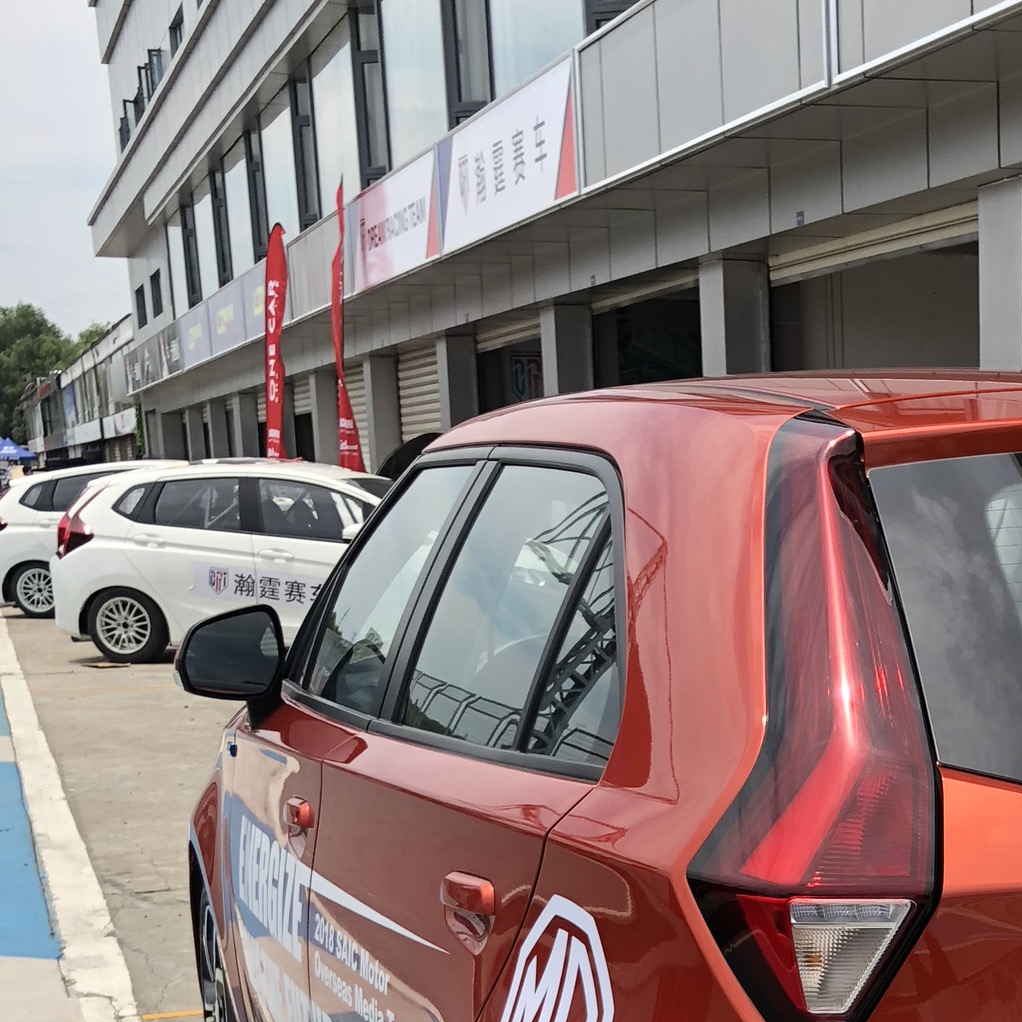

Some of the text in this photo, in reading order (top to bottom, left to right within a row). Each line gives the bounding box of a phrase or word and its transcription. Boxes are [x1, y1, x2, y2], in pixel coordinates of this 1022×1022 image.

[407, 196, 426, 229] TEAM
[239, 815, 303, 962] ENERGIZE
[314, 913, 390, 996] 2018 SAIC Motor
[314, 950, 352, 1007] Overseas
